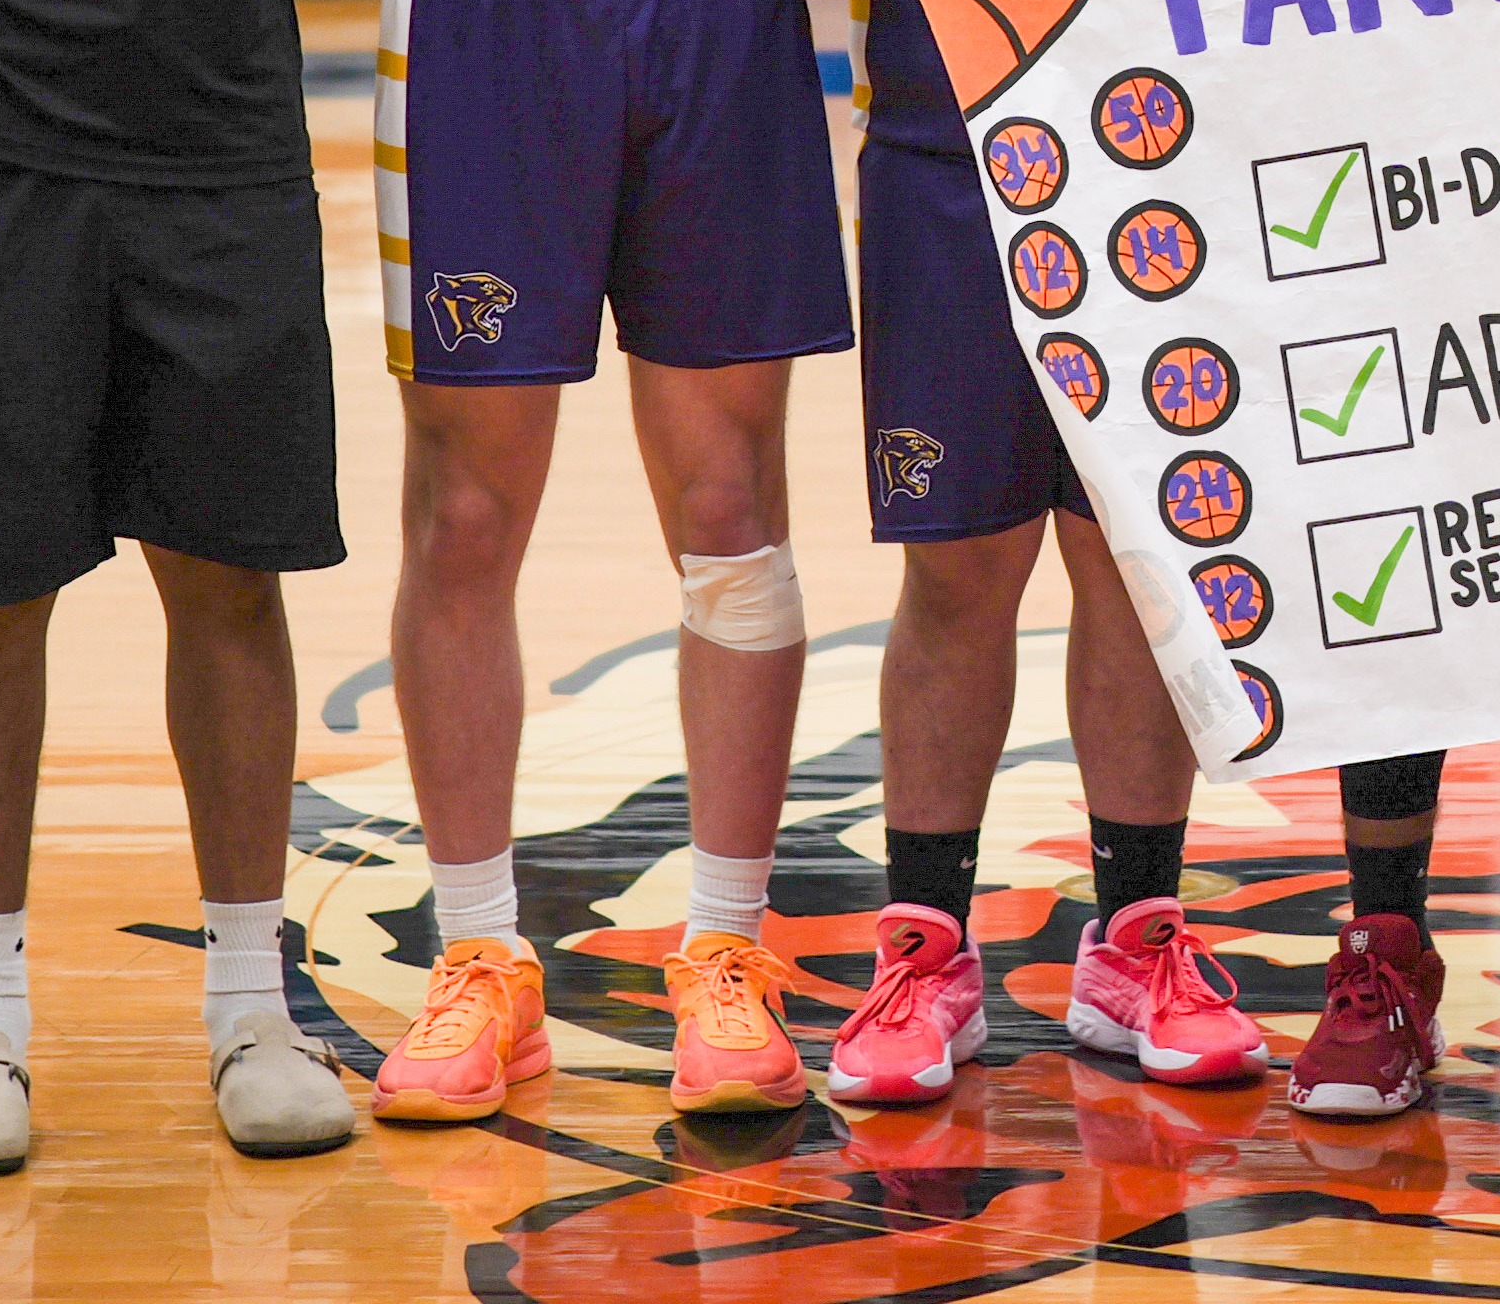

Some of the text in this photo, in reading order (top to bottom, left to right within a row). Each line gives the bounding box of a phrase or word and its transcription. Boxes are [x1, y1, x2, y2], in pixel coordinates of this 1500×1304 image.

[1109, 84, 1175, 143] 50
[990, 130, 1056, 190] 34
[1020, 240, 1071, 292] 12
[1129, 225, 1183, 276] 14
[1155, 358, 1223, 409] 20
[1168, 466, 1233, 520] 24
[1195, 574, 1257, 624] 42
